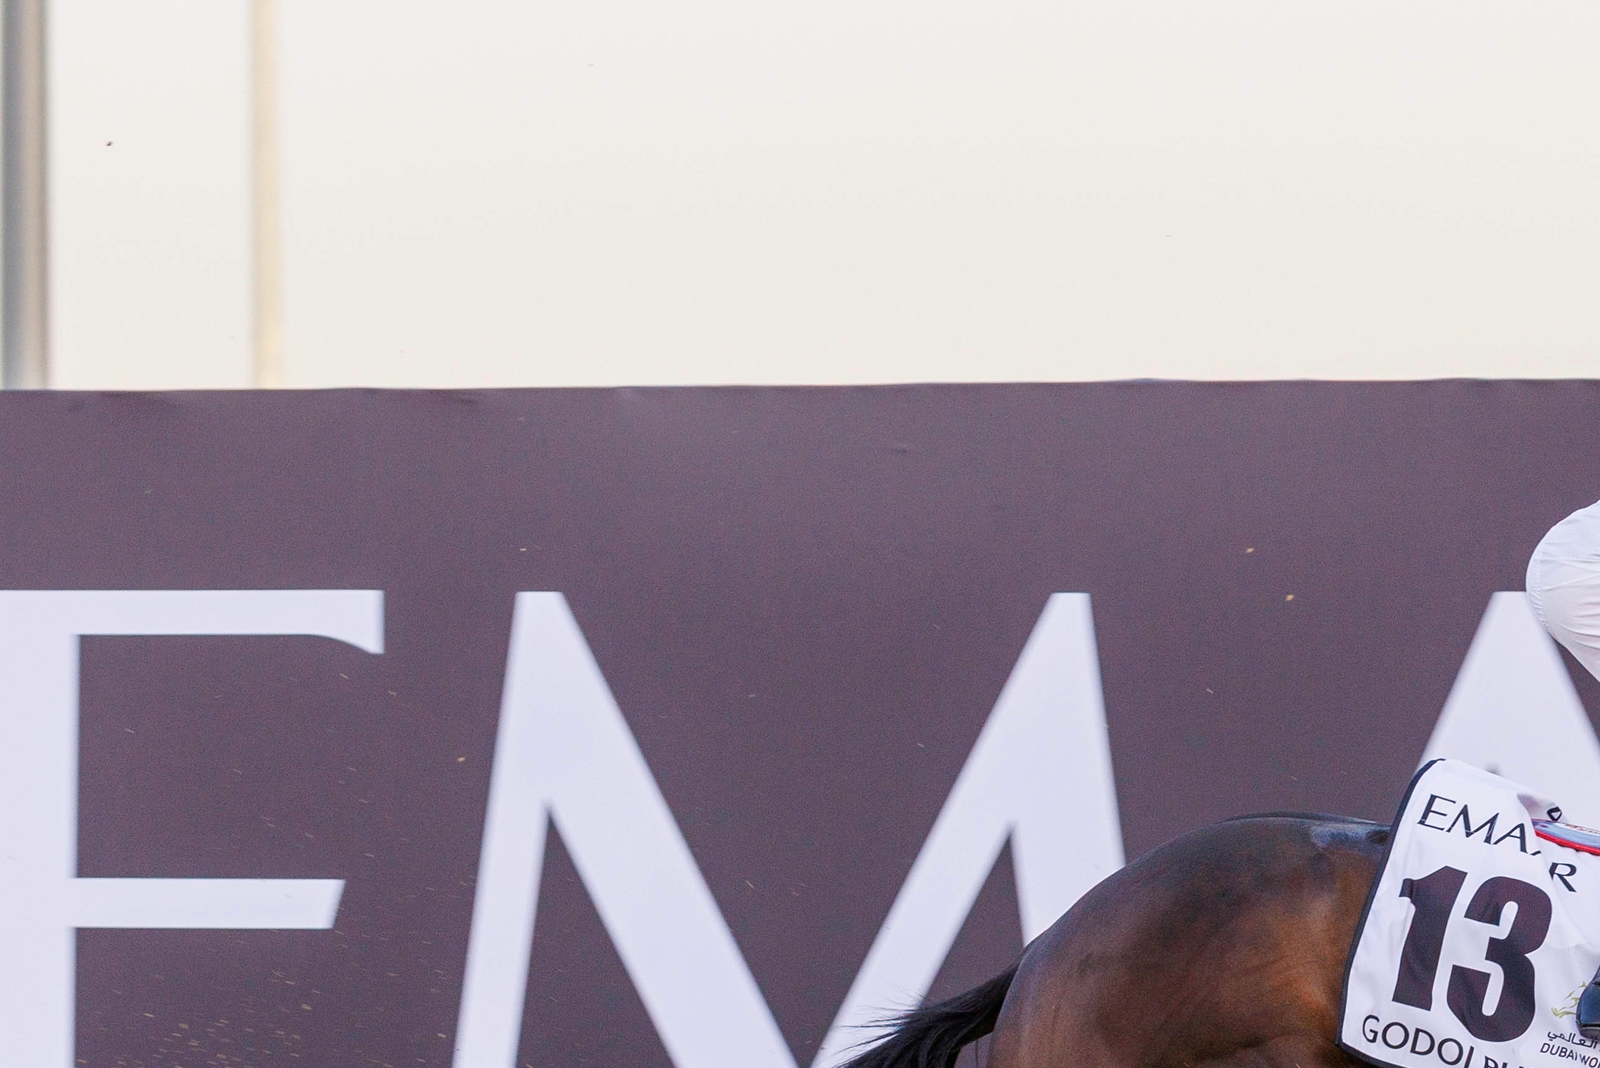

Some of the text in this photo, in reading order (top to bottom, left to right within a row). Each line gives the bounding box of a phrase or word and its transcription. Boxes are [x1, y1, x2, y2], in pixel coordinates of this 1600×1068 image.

[1417, 794, 1577, 893] EMAR
[1391, 865, 1553, 1043] 13
[1540, 1042, 1578, 1061] DUBAI
